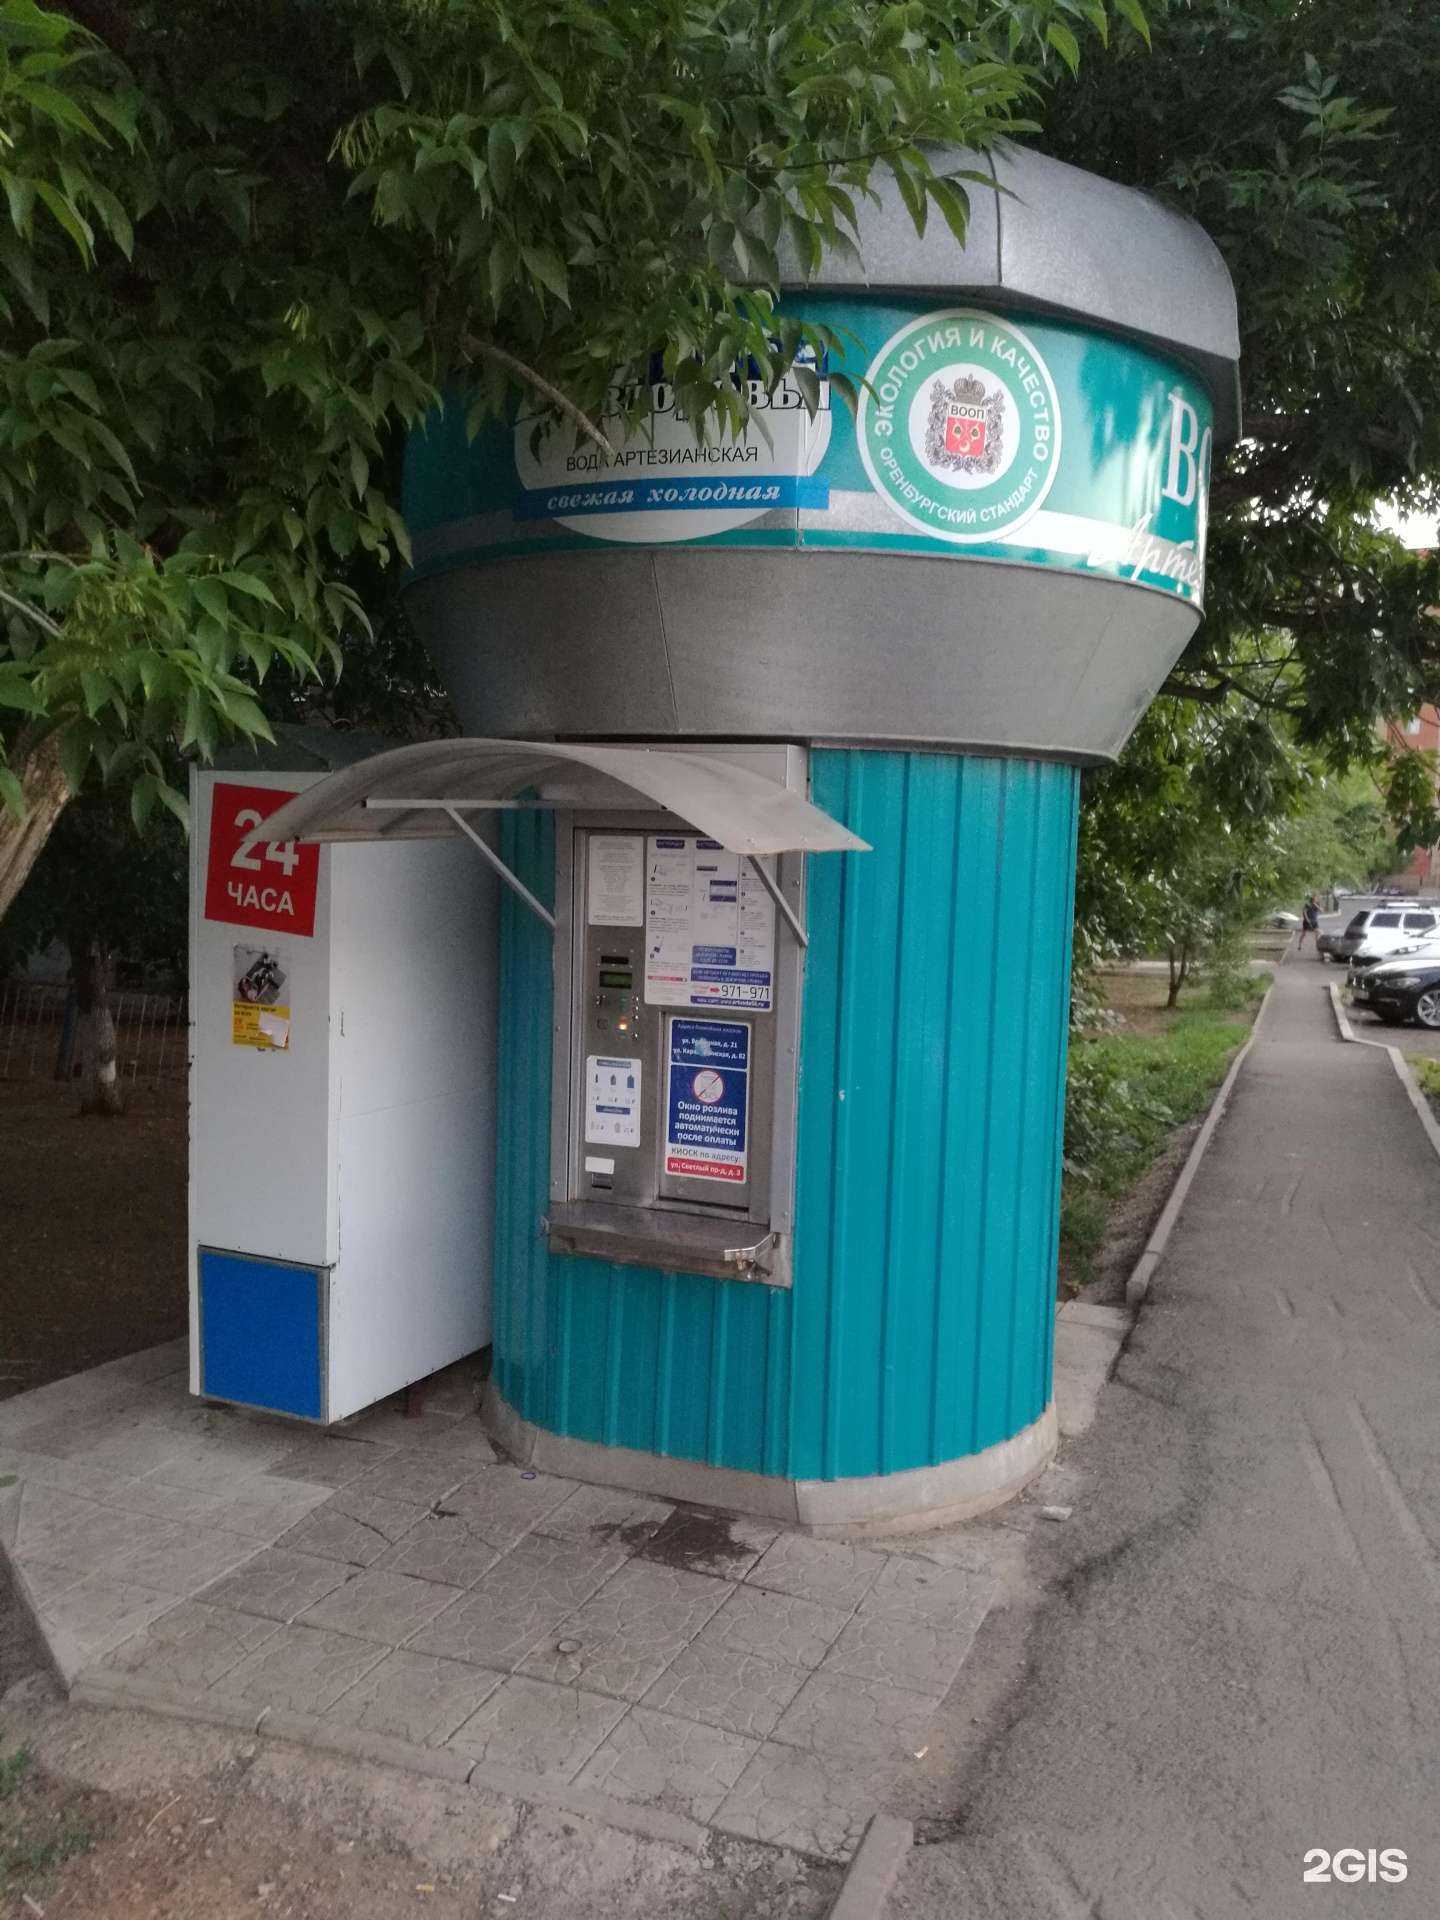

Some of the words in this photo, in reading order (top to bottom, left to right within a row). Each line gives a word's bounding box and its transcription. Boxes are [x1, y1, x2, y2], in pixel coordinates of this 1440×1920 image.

[874, 327, 962, 437] ЭКОЛОГИЯ
[969, 328, 986, 349] И
[990, 337, 1051, 462] КАЧЕСТВО
[950, 406, 985, 420] ВООП
[613, 446, 759, 468] АРТЕЗИАНСКАЯ
[880, 447, 977, 524] ОРЕНБУРГСКИЙ
[979, 467, 1039, 523] СТАНДАРТ
[547, 488, 635, 510] свежая
[646, 481, 781, 503] холодная
[229, 808, 301, 877] 24
[227, 880, 295, 917] ЧАСА
[721, 985, 770, 1000] 971-971
[677, 1101, 700, 1111] Окно
[702, 1105, 738, 1116] розлива
[679, 1112, 737, 1125] поднимается
[674, 1122, 740, 1136] автоматически
[677, 1132, 703, 1142] после
[704, 1136, 737, 1146] оплаты
